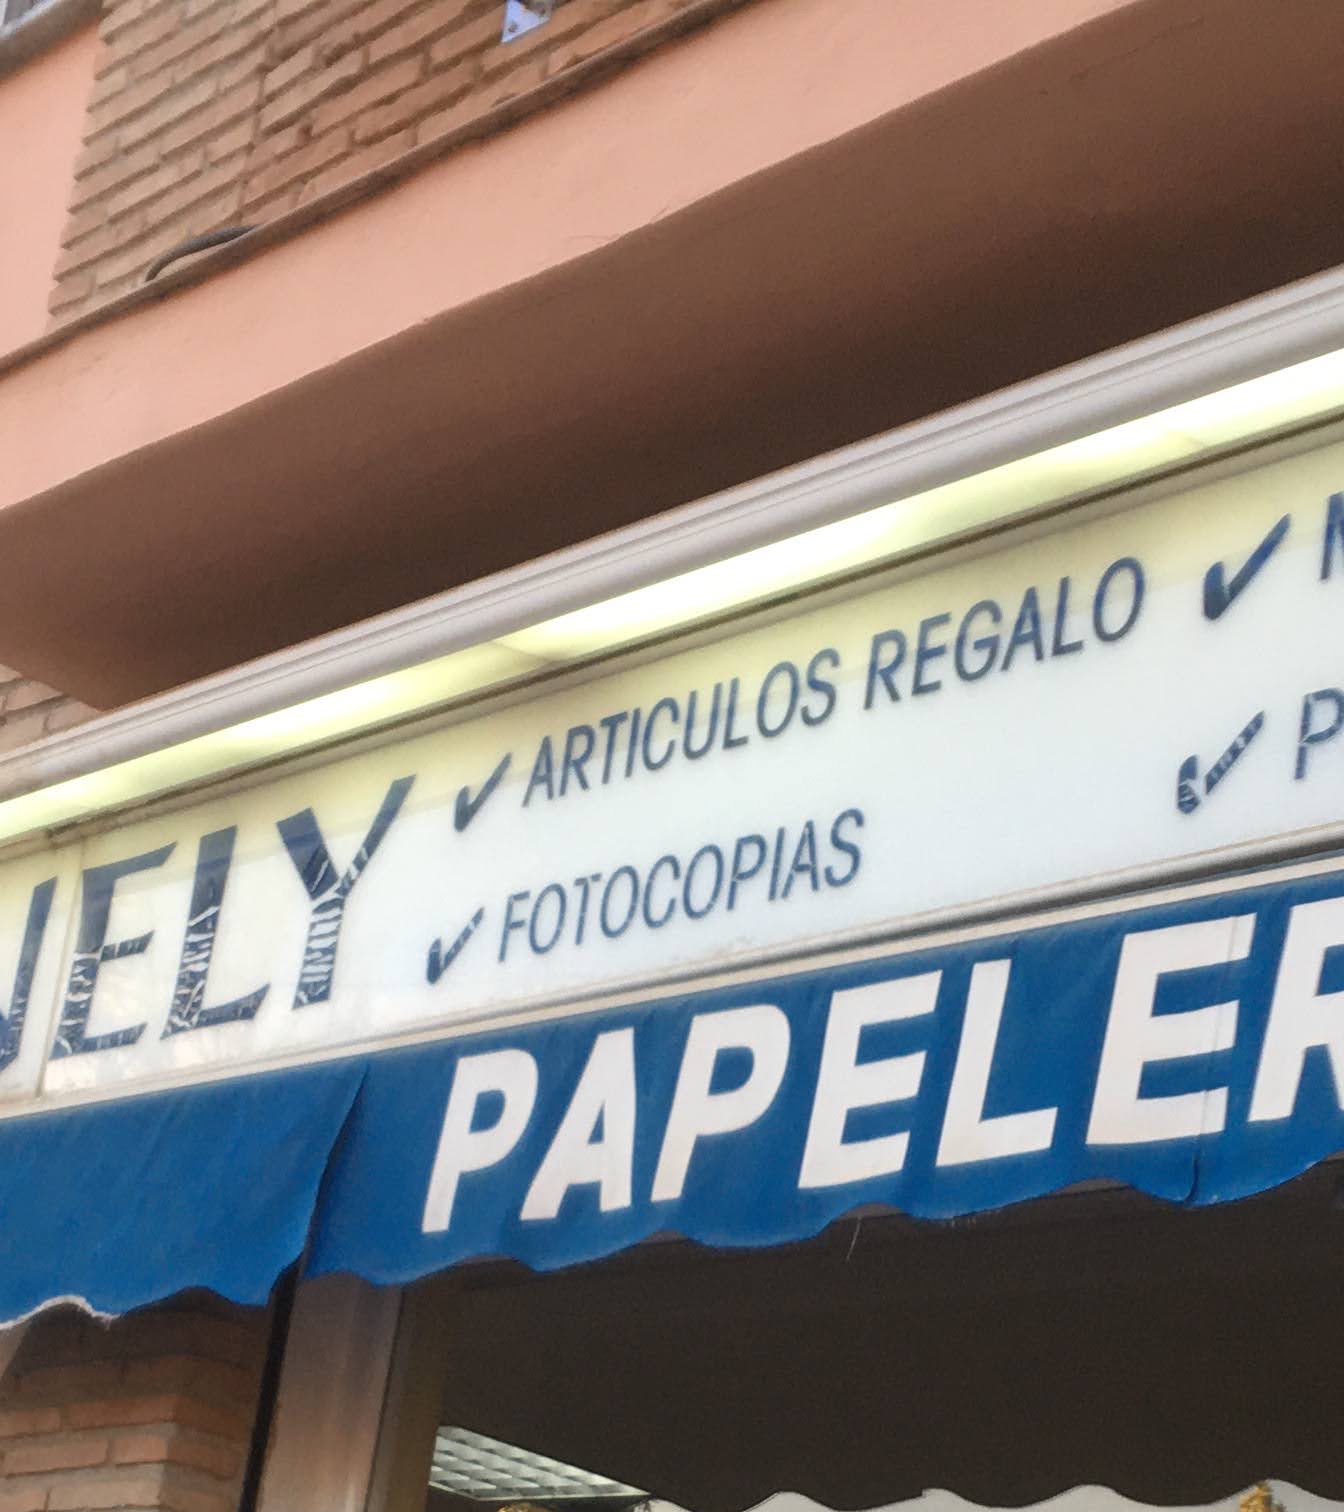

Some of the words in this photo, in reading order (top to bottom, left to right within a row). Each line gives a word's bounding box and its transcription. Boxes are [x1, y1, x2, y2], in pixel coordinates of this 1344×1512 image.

[522, 647, 841, 805] ARTICULOS
[862, 556, 1146, 708] REGALO
[497, 808, 865, 964] FOTOCOPIAS
